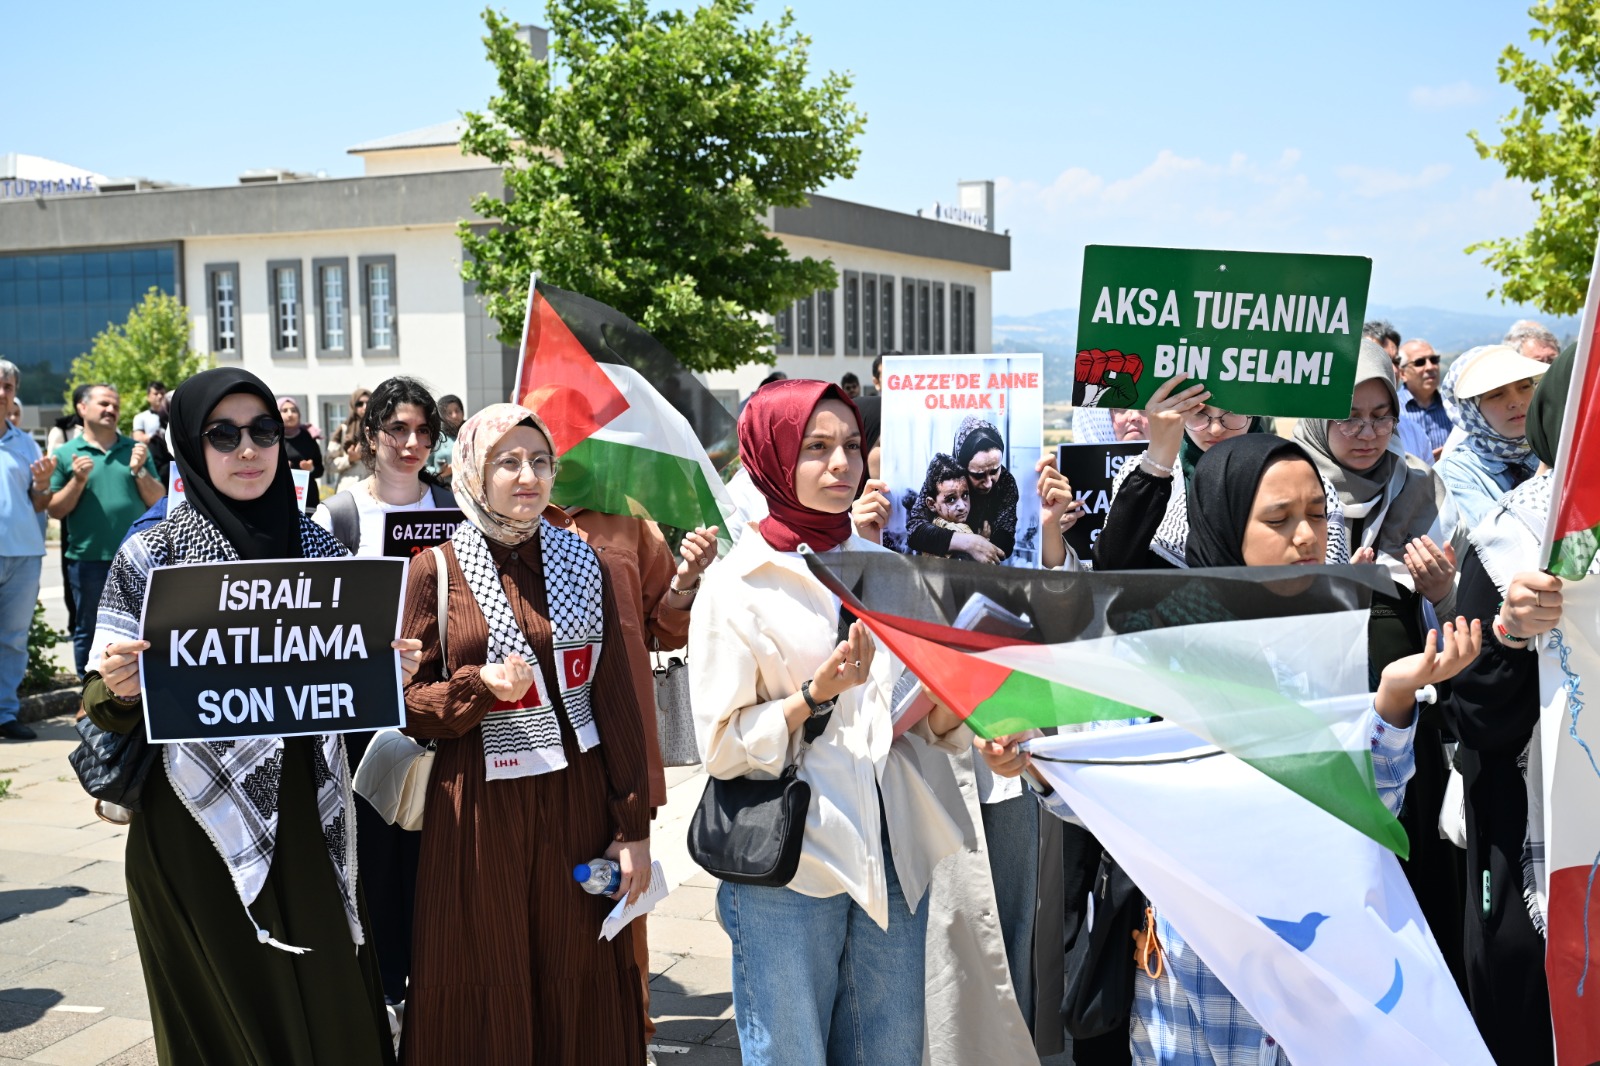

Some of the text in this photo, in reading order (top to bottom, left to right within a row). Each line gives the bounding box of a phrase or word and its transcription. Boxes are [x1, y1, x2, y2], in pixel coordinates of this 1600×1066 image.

[1091, 286, 1350, 335] AKSA TUFANINA
[887, 372, 1039, 391] GAZZE'DE ANNE
[1153, 338, 1334, 386] BİN SELAM!
[924, 393, 993, 410] OLMAK
[392, 523, 460, 541] GAZZE'D
[218, 571, 342, 611] İSRAİL !
[169, 618, 369, 667] KATLİAMA
[197, 683, 356, 725] SON VER
